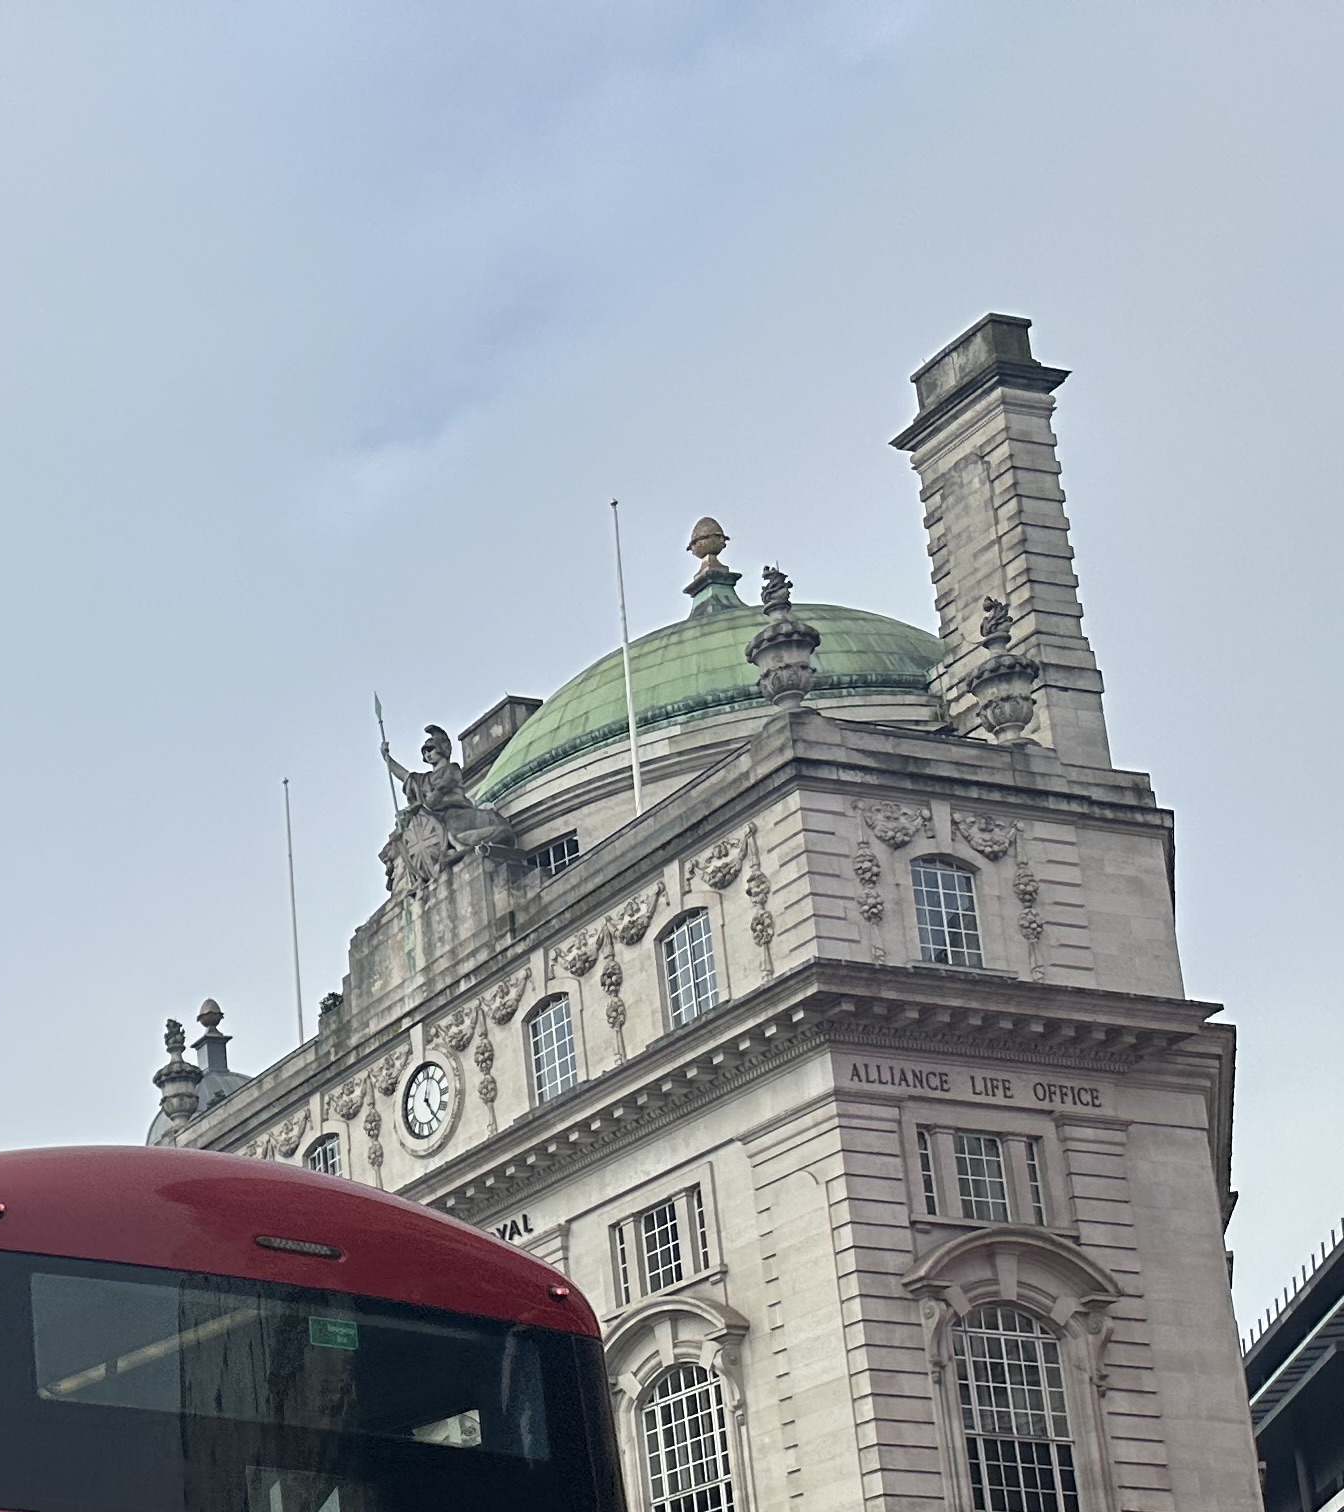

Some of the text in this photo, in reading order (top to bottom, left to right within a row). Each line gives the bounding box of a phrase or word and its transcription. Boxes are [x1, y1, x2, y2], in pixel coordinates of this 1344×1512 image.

[850, 1063, 1102, 1108] ALLIANCE LIFE OFFICE
[490, 1213, 534, 1241] YAL
